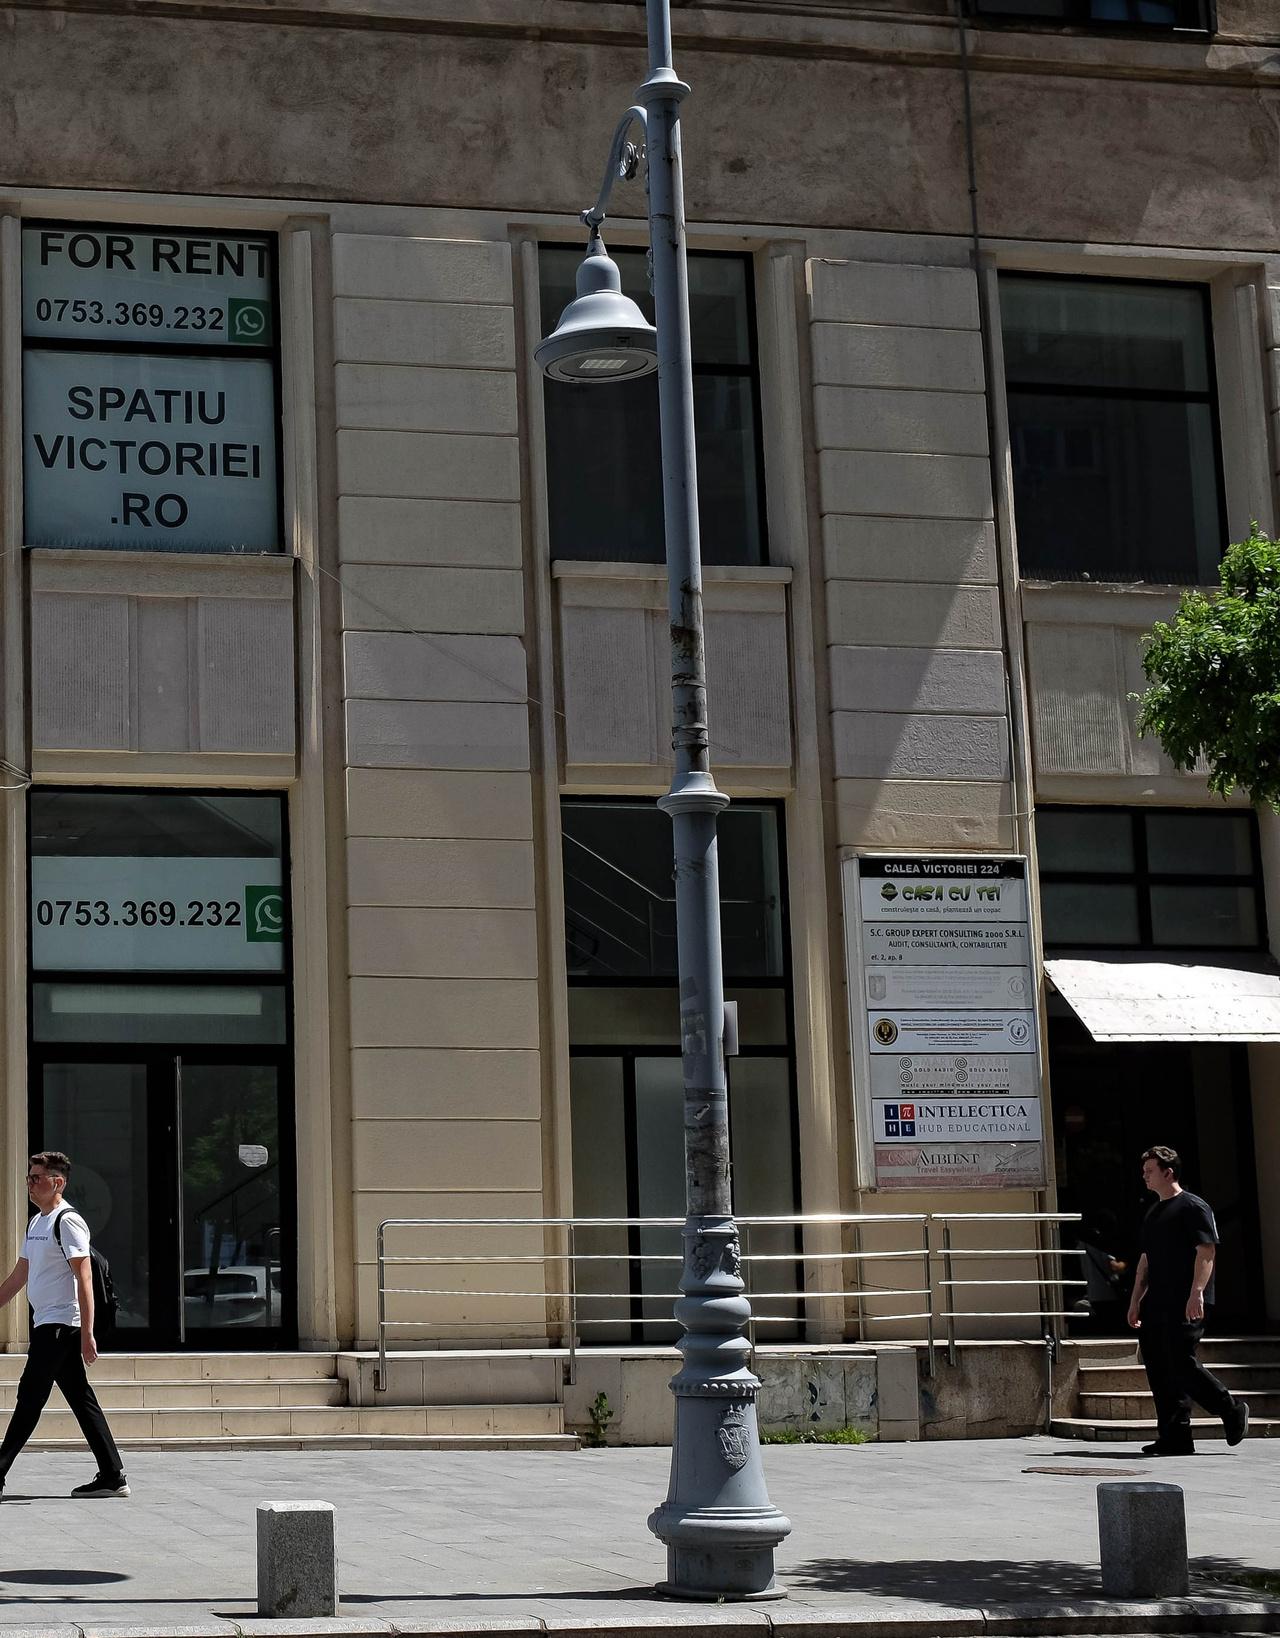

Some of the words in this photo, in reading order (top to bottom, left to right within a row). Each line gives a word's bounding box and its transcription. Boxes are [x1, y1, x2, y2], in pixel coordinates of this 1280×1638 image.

[40, 232, 136, 270] FOR
[152, 238, 268, 278] RENT
[36, 298, 224, 331] 0753.369.232
[68, 386, 226, 425] SPATIU
[33, 434, 260, 478] VICTORIEI
[111, 492, 188, 528] .RO
[884, 864, 920, 874] CALEA
[923, 865, 977, 874] VICTORIEI
[980, 865, 1000, 874] 224
[902, 885, 944, 901] CASA
[948, 885, 971, 901] CU
[976, 886, 1001, 901] TEI
[37, 900, 242, 926] 0753.369.232
[870, 929, 883, 937] S.C.
[885, 929, 911, 937] GROUP
[912, 929, 937, 938] EXPERT
[939, 929, 983, 938] CONSULTING
[1005, 929, 1025, 938] S.R.L.
[960, 941, 1007, 949] CONTABILITATE
[918, 1105, 1027, 1118] INTELECTICA
[919, 1125, 943, 1133] HUB
